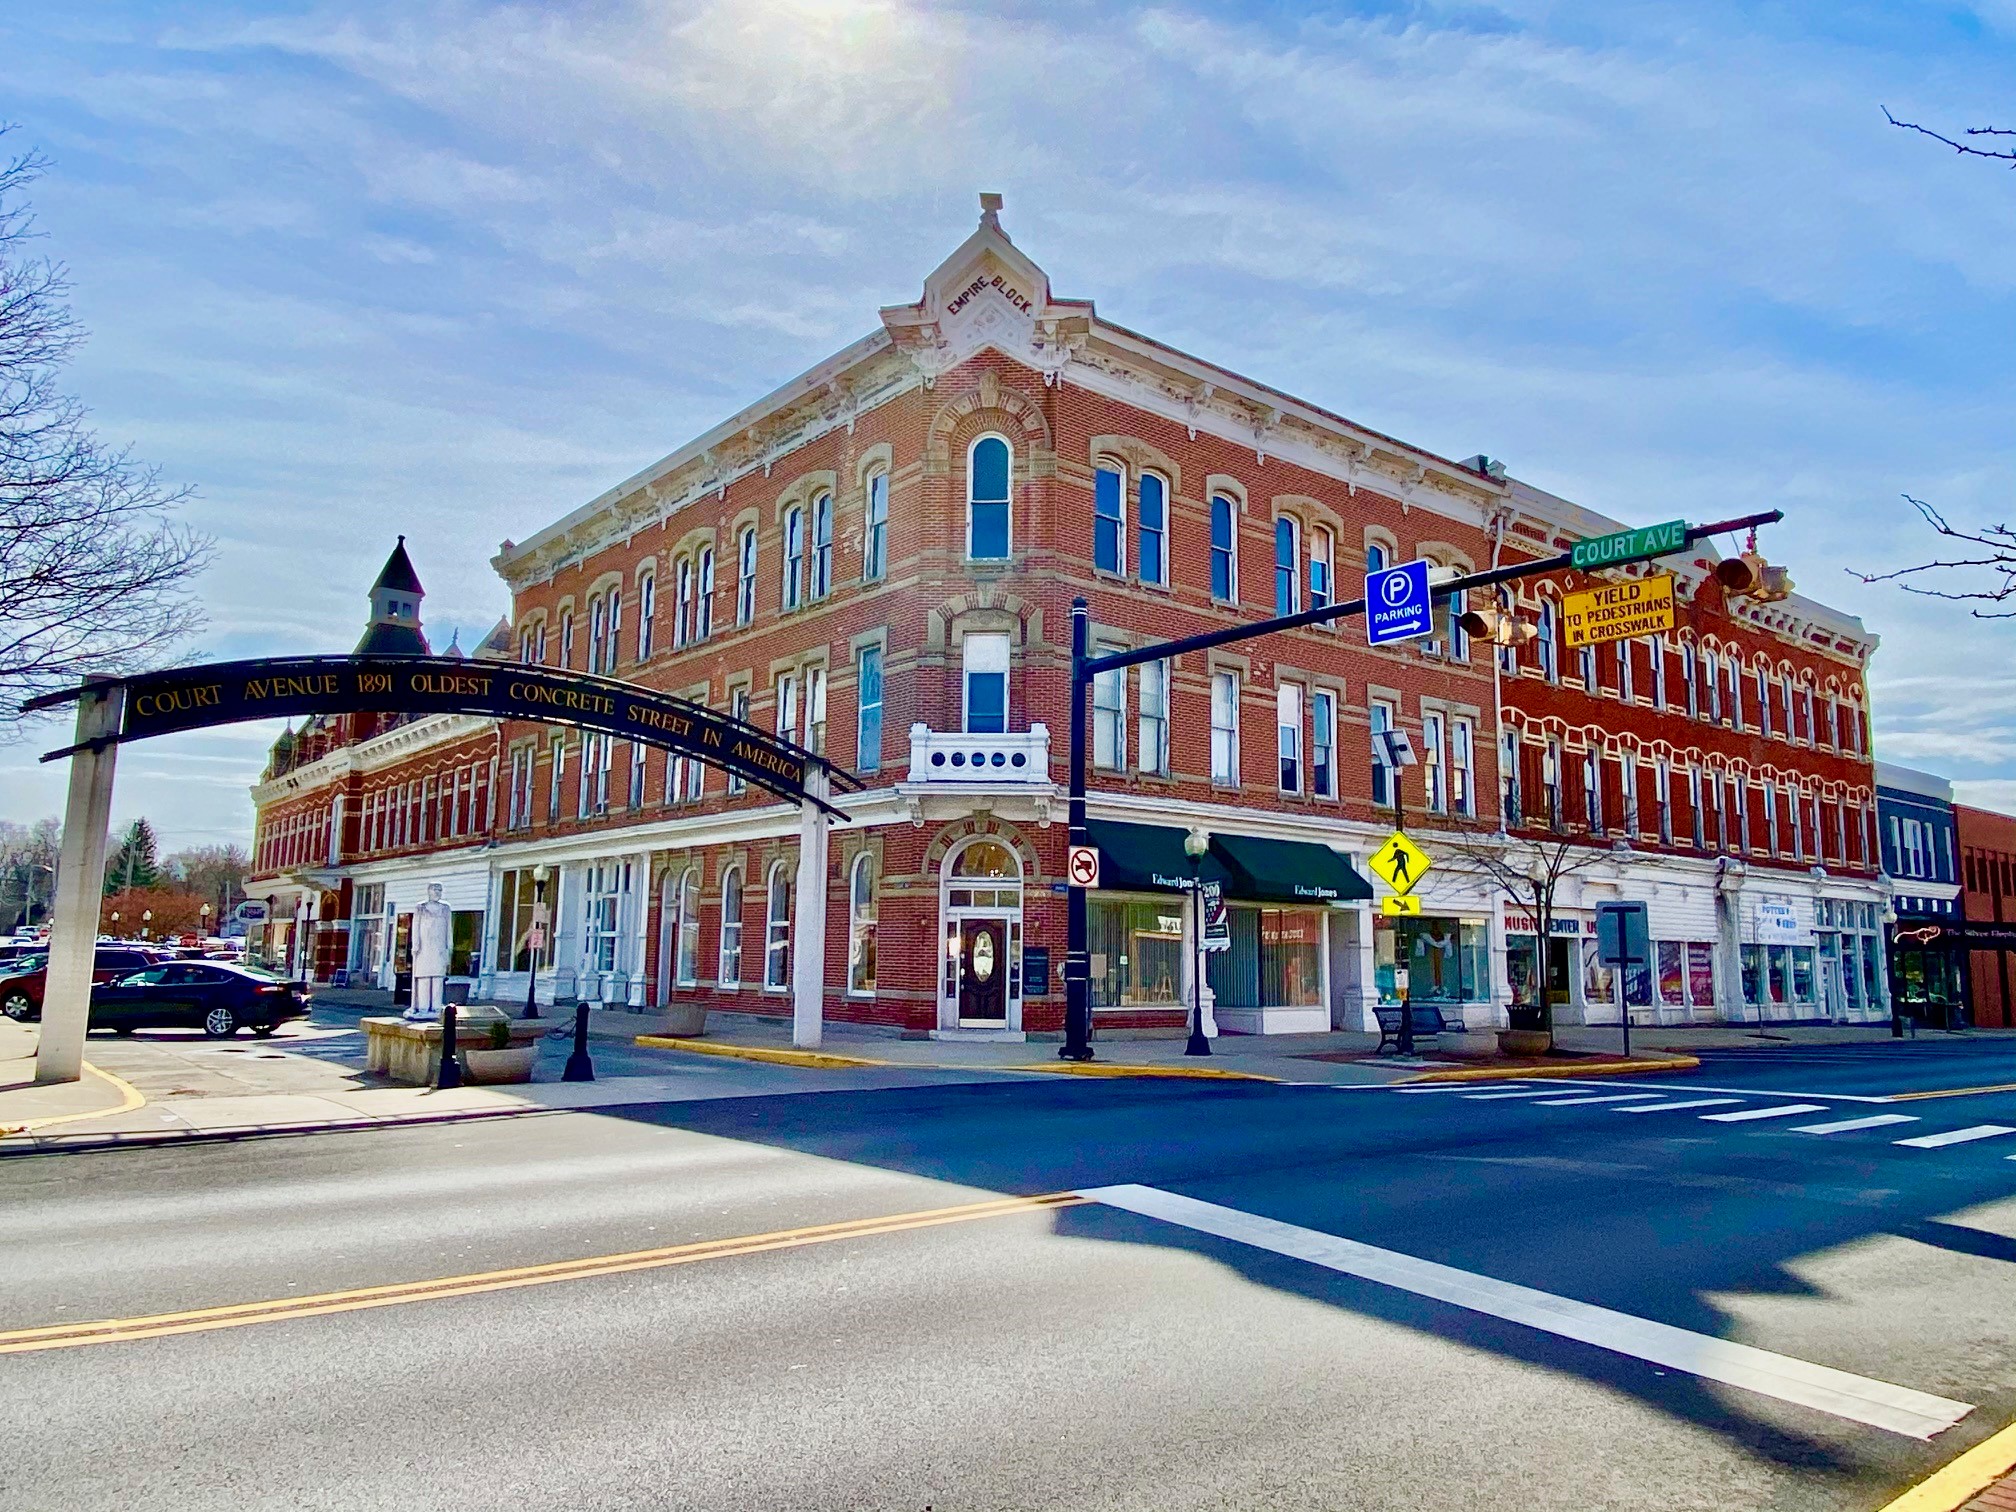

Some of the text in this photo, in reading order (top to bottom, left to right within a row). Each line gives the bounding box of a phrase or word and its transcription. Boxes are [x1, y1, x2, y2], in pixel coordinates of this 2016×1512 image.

[946, 275, 990, 315] EMPIRE
[1573, 524, 1684, 565] COURT AVE
[1389, 576, 1406, 601] P
[1593, 584, 1641, 606] YIELD
[1374, 603, 1423, 624] PARKING
[1565, 596, 1672, 627] TO PEDESTRIANS
[1572, 614, 1665, 643] IN CROSSWALK
[136, 673, 802, 783] COURT AVENUE 1891 OLDEST CONCRETE STREET IN AMERICA
[1152, 873, 1179, 888] Edward
[1294, 884, 1338, 898] Edward Jones
[1549, 919, 1580, 934] ENTER
